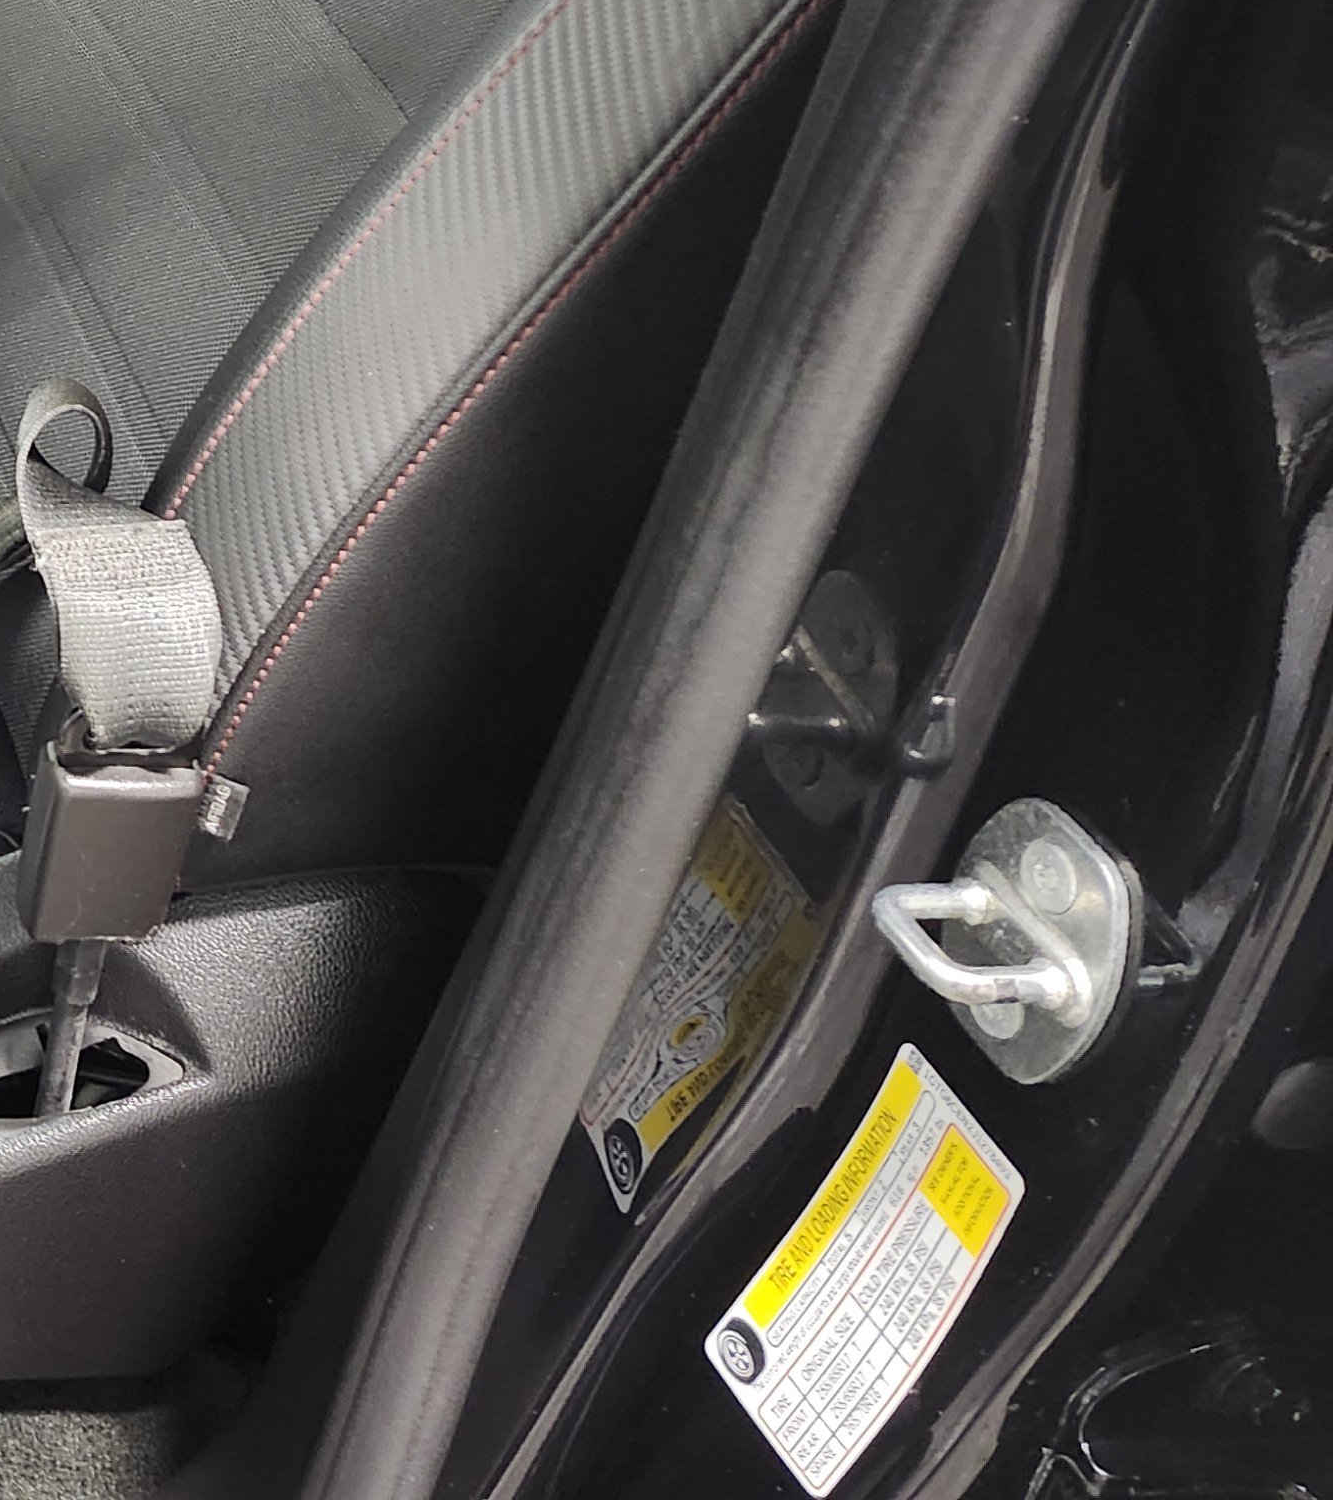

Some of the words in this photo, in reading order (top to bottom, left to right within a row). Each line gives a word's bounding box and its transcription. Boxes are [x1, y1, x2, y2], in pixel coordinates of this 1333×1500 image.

[769, 1257, 797, 1293] TIRE
[788, 1234, 814, 1268] AND
[806, 1184, 849, 1241] LOADING
[842, 1111, 896, 1193] INFORMATION
[802, 1340, 838, 1381] ORIGINAL
[891, 1198, 930, 1255] PRESSURE
